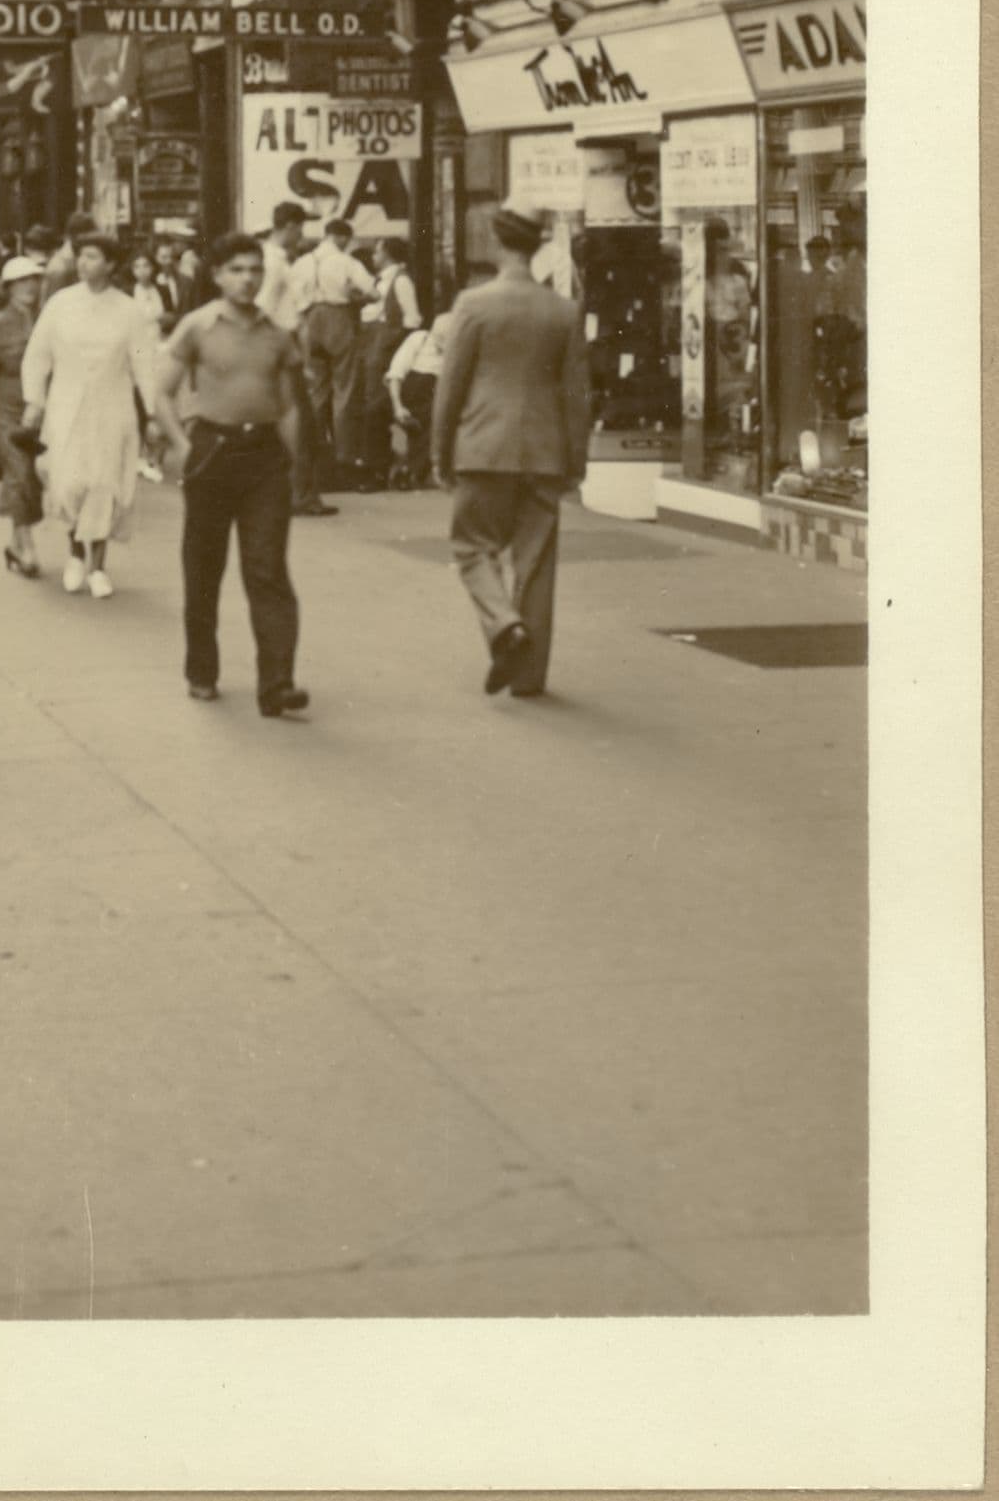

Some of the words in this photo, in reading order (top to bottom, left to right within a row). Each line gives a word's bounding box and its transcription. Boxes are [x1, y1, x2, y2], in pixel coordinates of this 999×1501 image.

[104, 10, 221, 34] WILLIAM
[236, 11, 306, 35] BELL
[317, 13, 365, 36] O.D.
[327, 108, 417, 146] PHOTOS
[356, 138, 390, 155] 10
